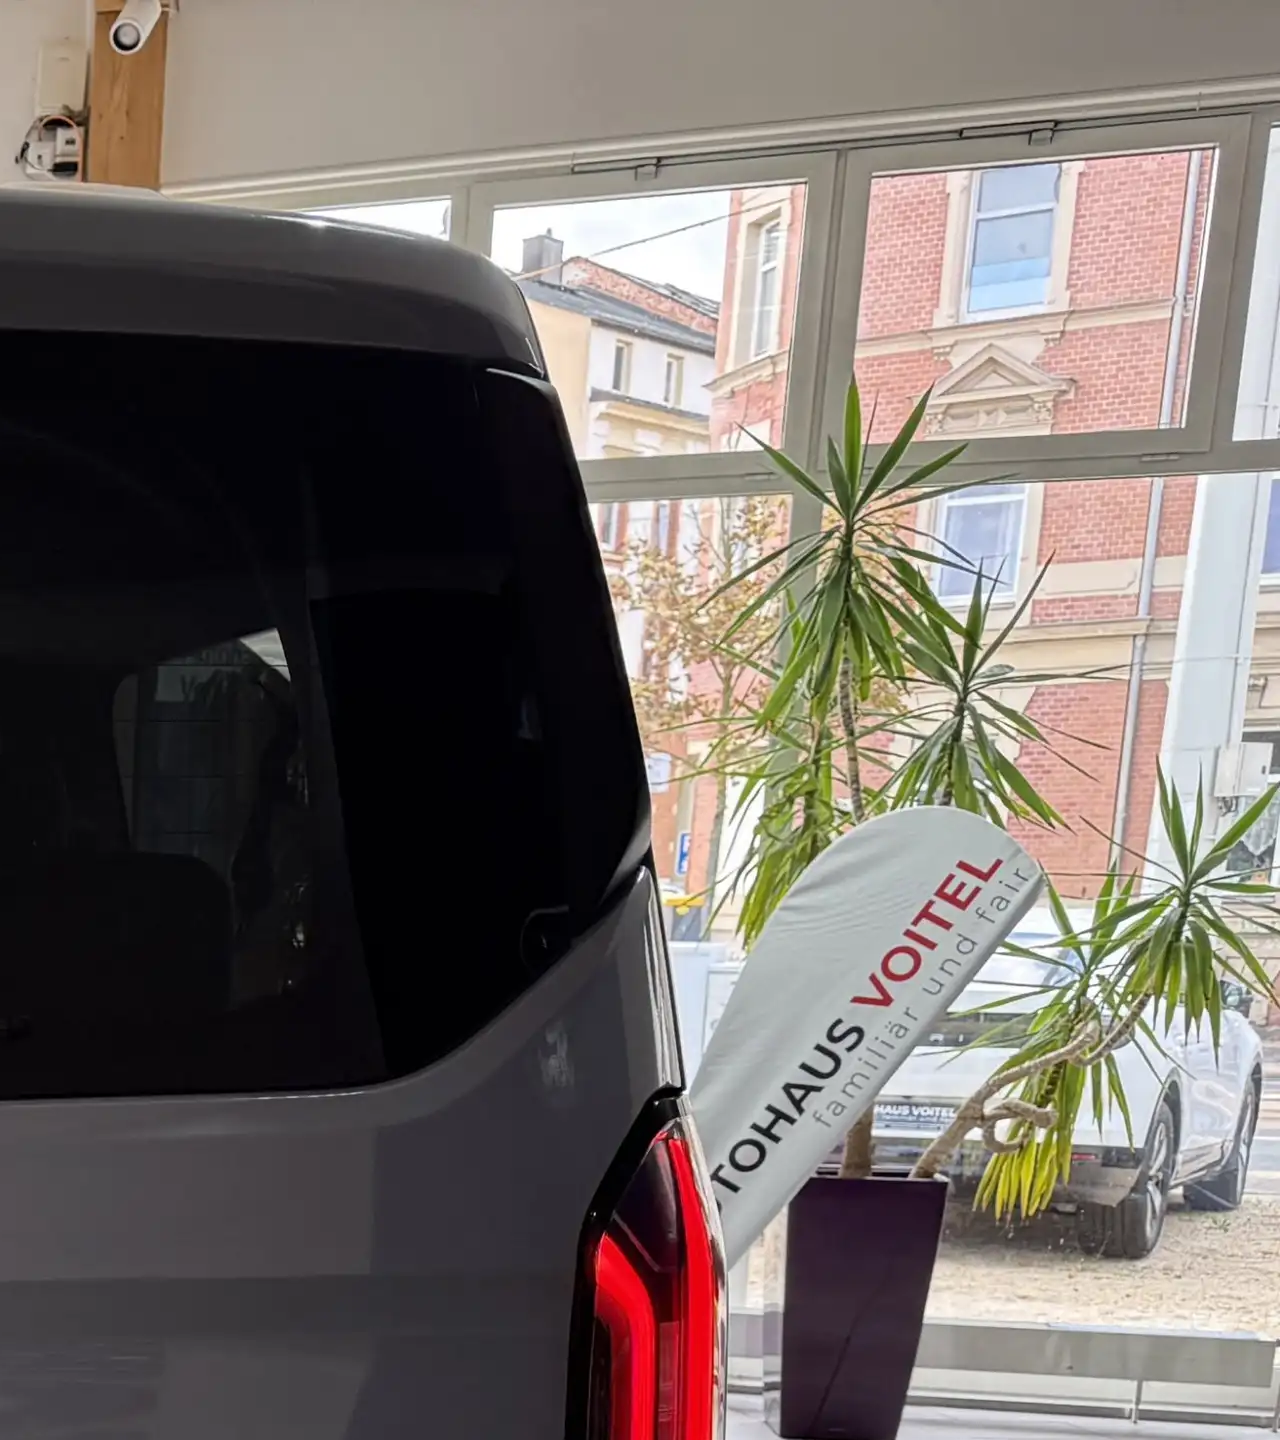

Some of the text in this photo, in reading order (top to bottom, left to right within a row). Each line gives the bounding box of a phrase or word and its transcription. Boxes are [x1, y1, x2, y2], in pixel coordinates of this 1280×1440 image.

[709, 1017, 865, 1213] TOHAUS
[850, 858, 1003, 1008] VOITEL
[812, 1006, 920, 1128] familiär
[922, 933, 978, 996] und
[975, 867, 1030, 924] fair
[874, 1104, 910, 1115] HAUS
